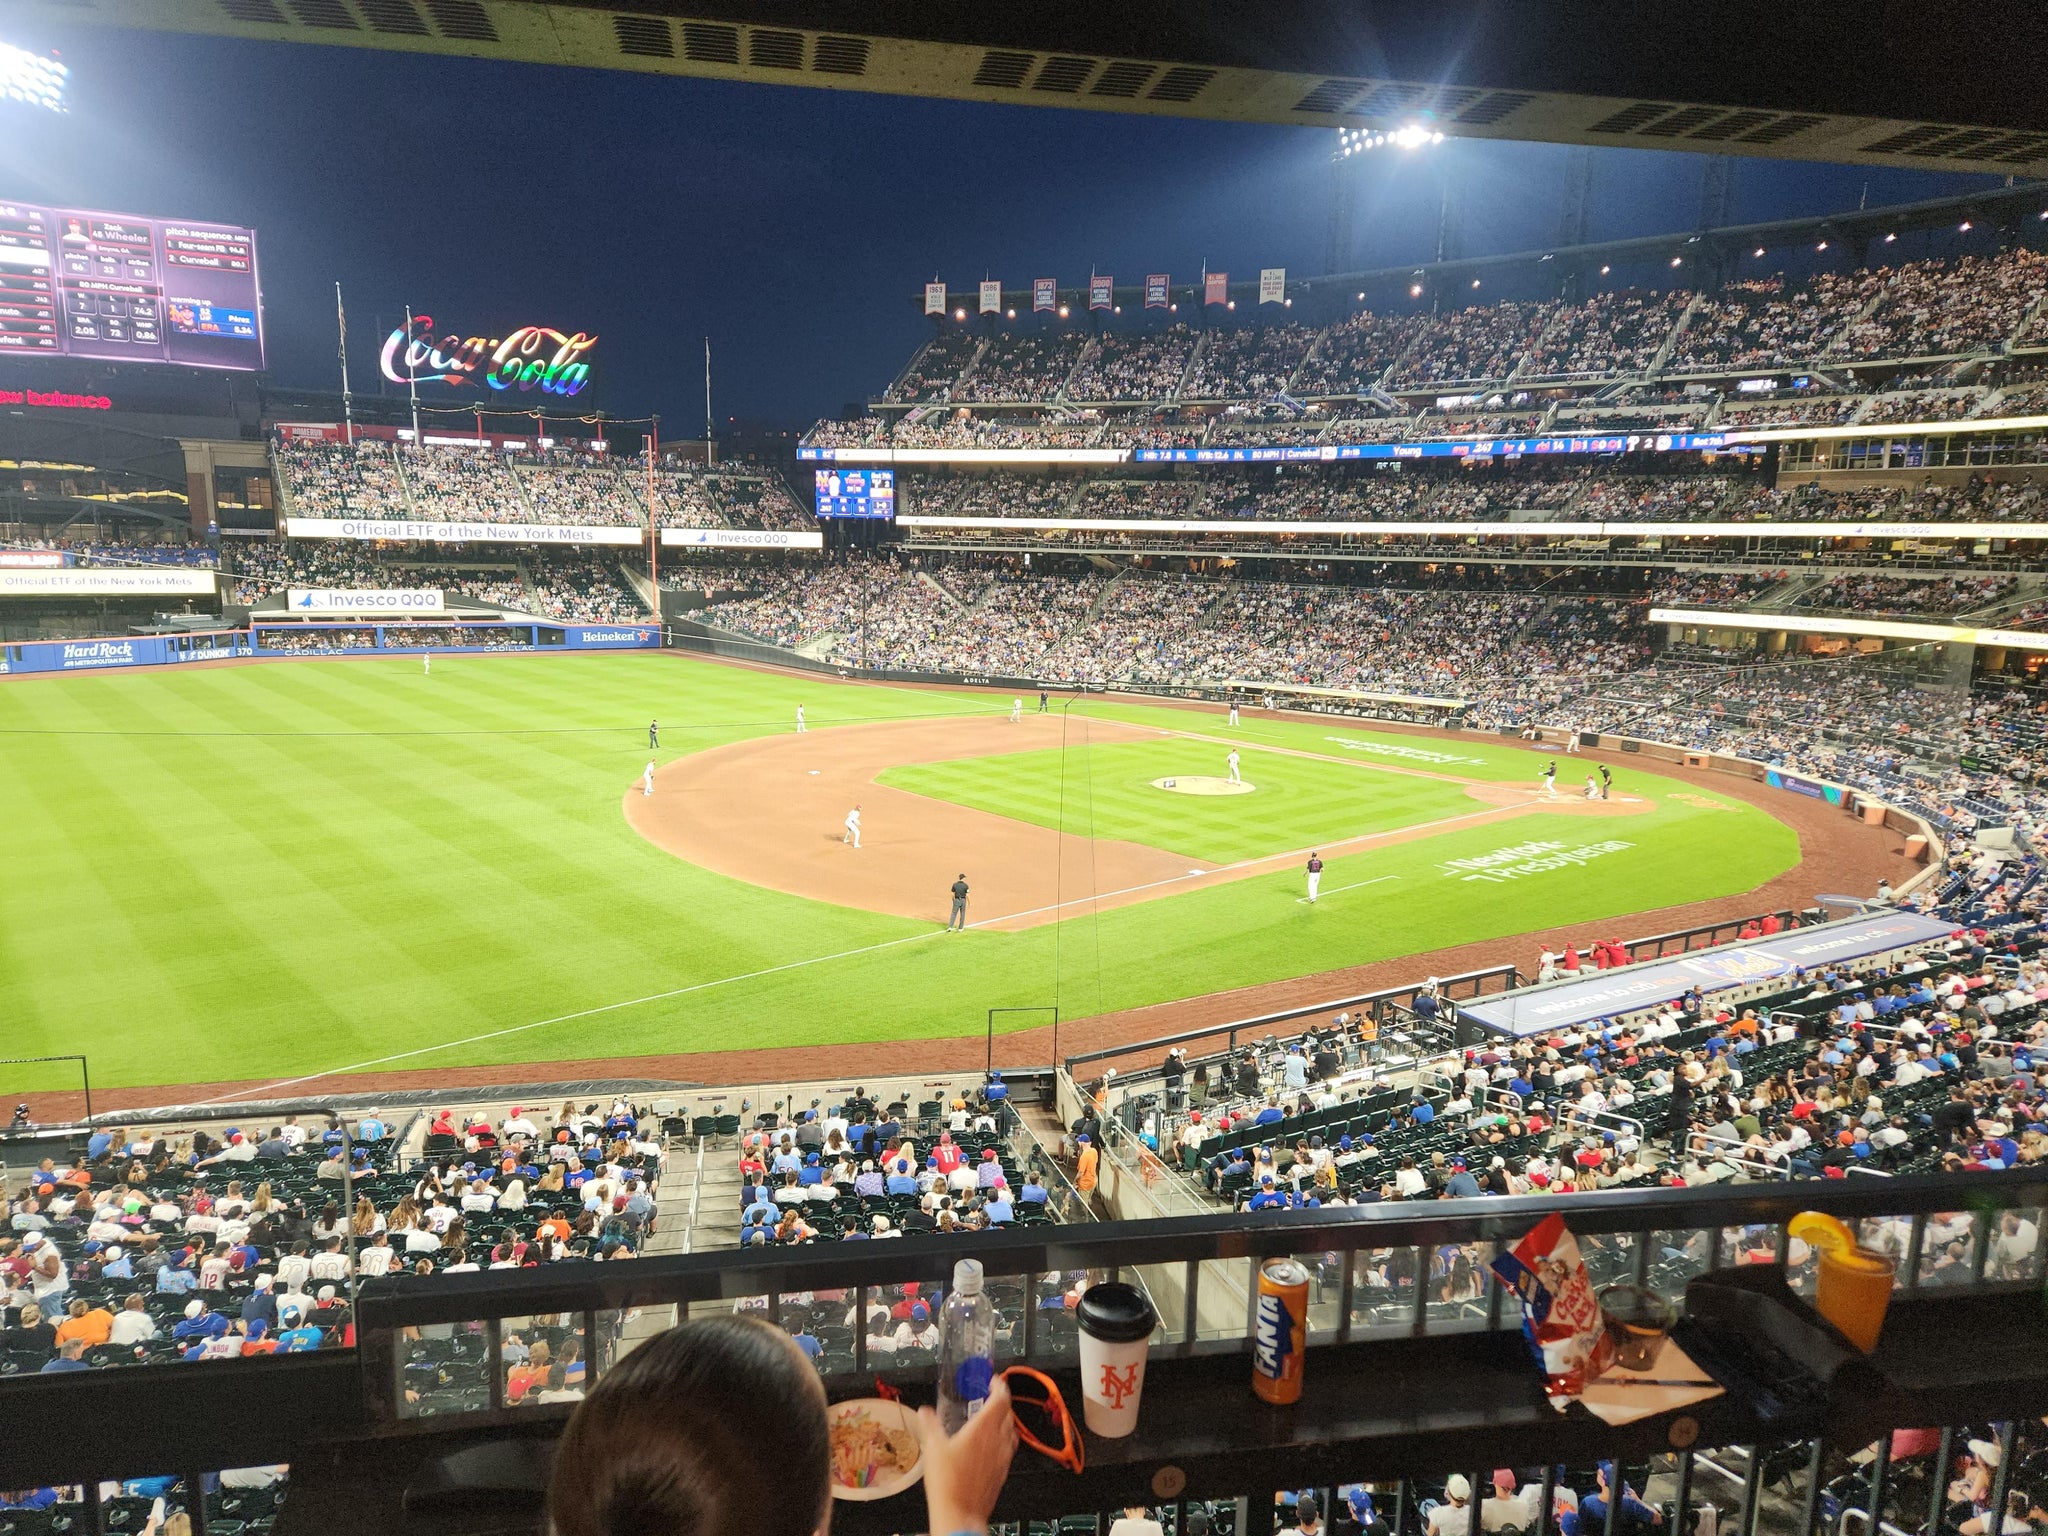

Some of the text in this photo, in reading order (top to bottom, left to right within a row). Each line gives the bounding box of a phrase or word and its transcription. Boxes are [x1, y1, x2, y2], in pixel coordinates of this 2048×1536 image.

[103, 223, 123, 231] Zack
[104, 231, 148, 243] Wheeler
[165, 227, 189, 238] pitch
[190, 230, 232, 241] sequence
[100, 255, 115, 263] balls
[128, 258, 149, 266] strikes
[179, 255, 219, 265] Curveball
[90, 281, 108, 290] MPH
[109, 283, 143, 293] Curveball
[170, 296, 212, 307] warming up
[134, 306, 153, 315] 74.2
[201, 323, 219, 331] ERA
[380, 315, 598, 396] Coca-Cola
[27, 388, 111, 410] balance
[1518, 441, 1527, 452] 6
[1643, 438, 1654, 448] 2
[1263, 451, 1280, 459] MPH
[1287, 449, 1320, 458] Curveball
[1393, 446, 1423, 458] Young
[342, 522, 594, 540] Official ETF of the New York Mets
[1871, 526, 1908, 534] Invesco
[717, 532, 788, 545] Invesco QQQ
[5, 577, 192, 586] Official ETF of the New York Mets
[328, 593, 437, 607] Invesco QQQ
[582, 631, 635, 643] Heineken
[64, 642, 132, 658] Hard Rock
[237, 647, 253, 657] 370
[284, 649, 344, 657] CADILLAC
[75, 656, 134, 667] METROPOLITAN PARK
[1483, 840, 1637, 879] Presbyterian
[1791, 938, 1851, 954] welcome
[1850, 934, 1867, 943] to
[1864, 927, 1892, 940] citi
[1530, 992, 1611, 1015] welcome
[1609, 988, 1631, 998] to
[1628, 979, 1660, 993] citi
[943, 1151, 955, 1164] 11
[204, 1273, 218, 1289] 12
[1254, 1294, 1280, 1379] FANTA
